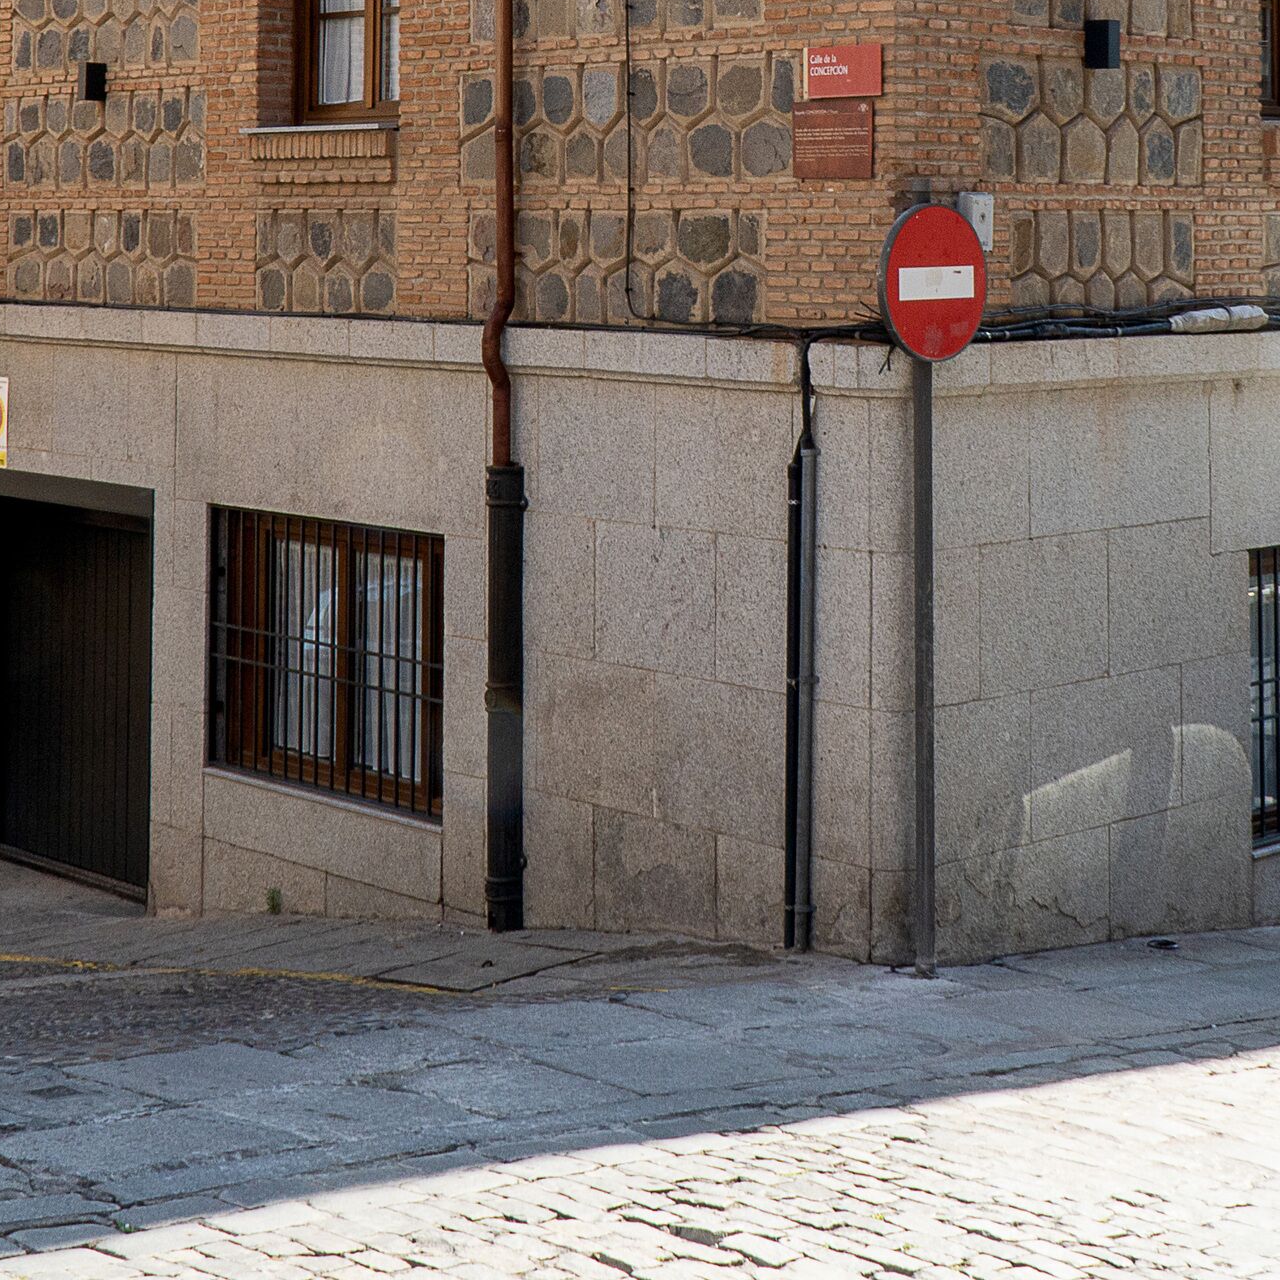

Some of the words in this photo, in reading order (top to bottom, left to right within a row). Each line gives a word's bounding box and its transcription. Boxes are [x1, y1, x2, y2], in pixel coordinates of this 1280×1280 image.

[809, 54, 823, 64] Calle
[823, 54, 831, 64] de
[831, 54, 837, 63] la
[810, 64, 848, 76] CONCEPCIÓN
